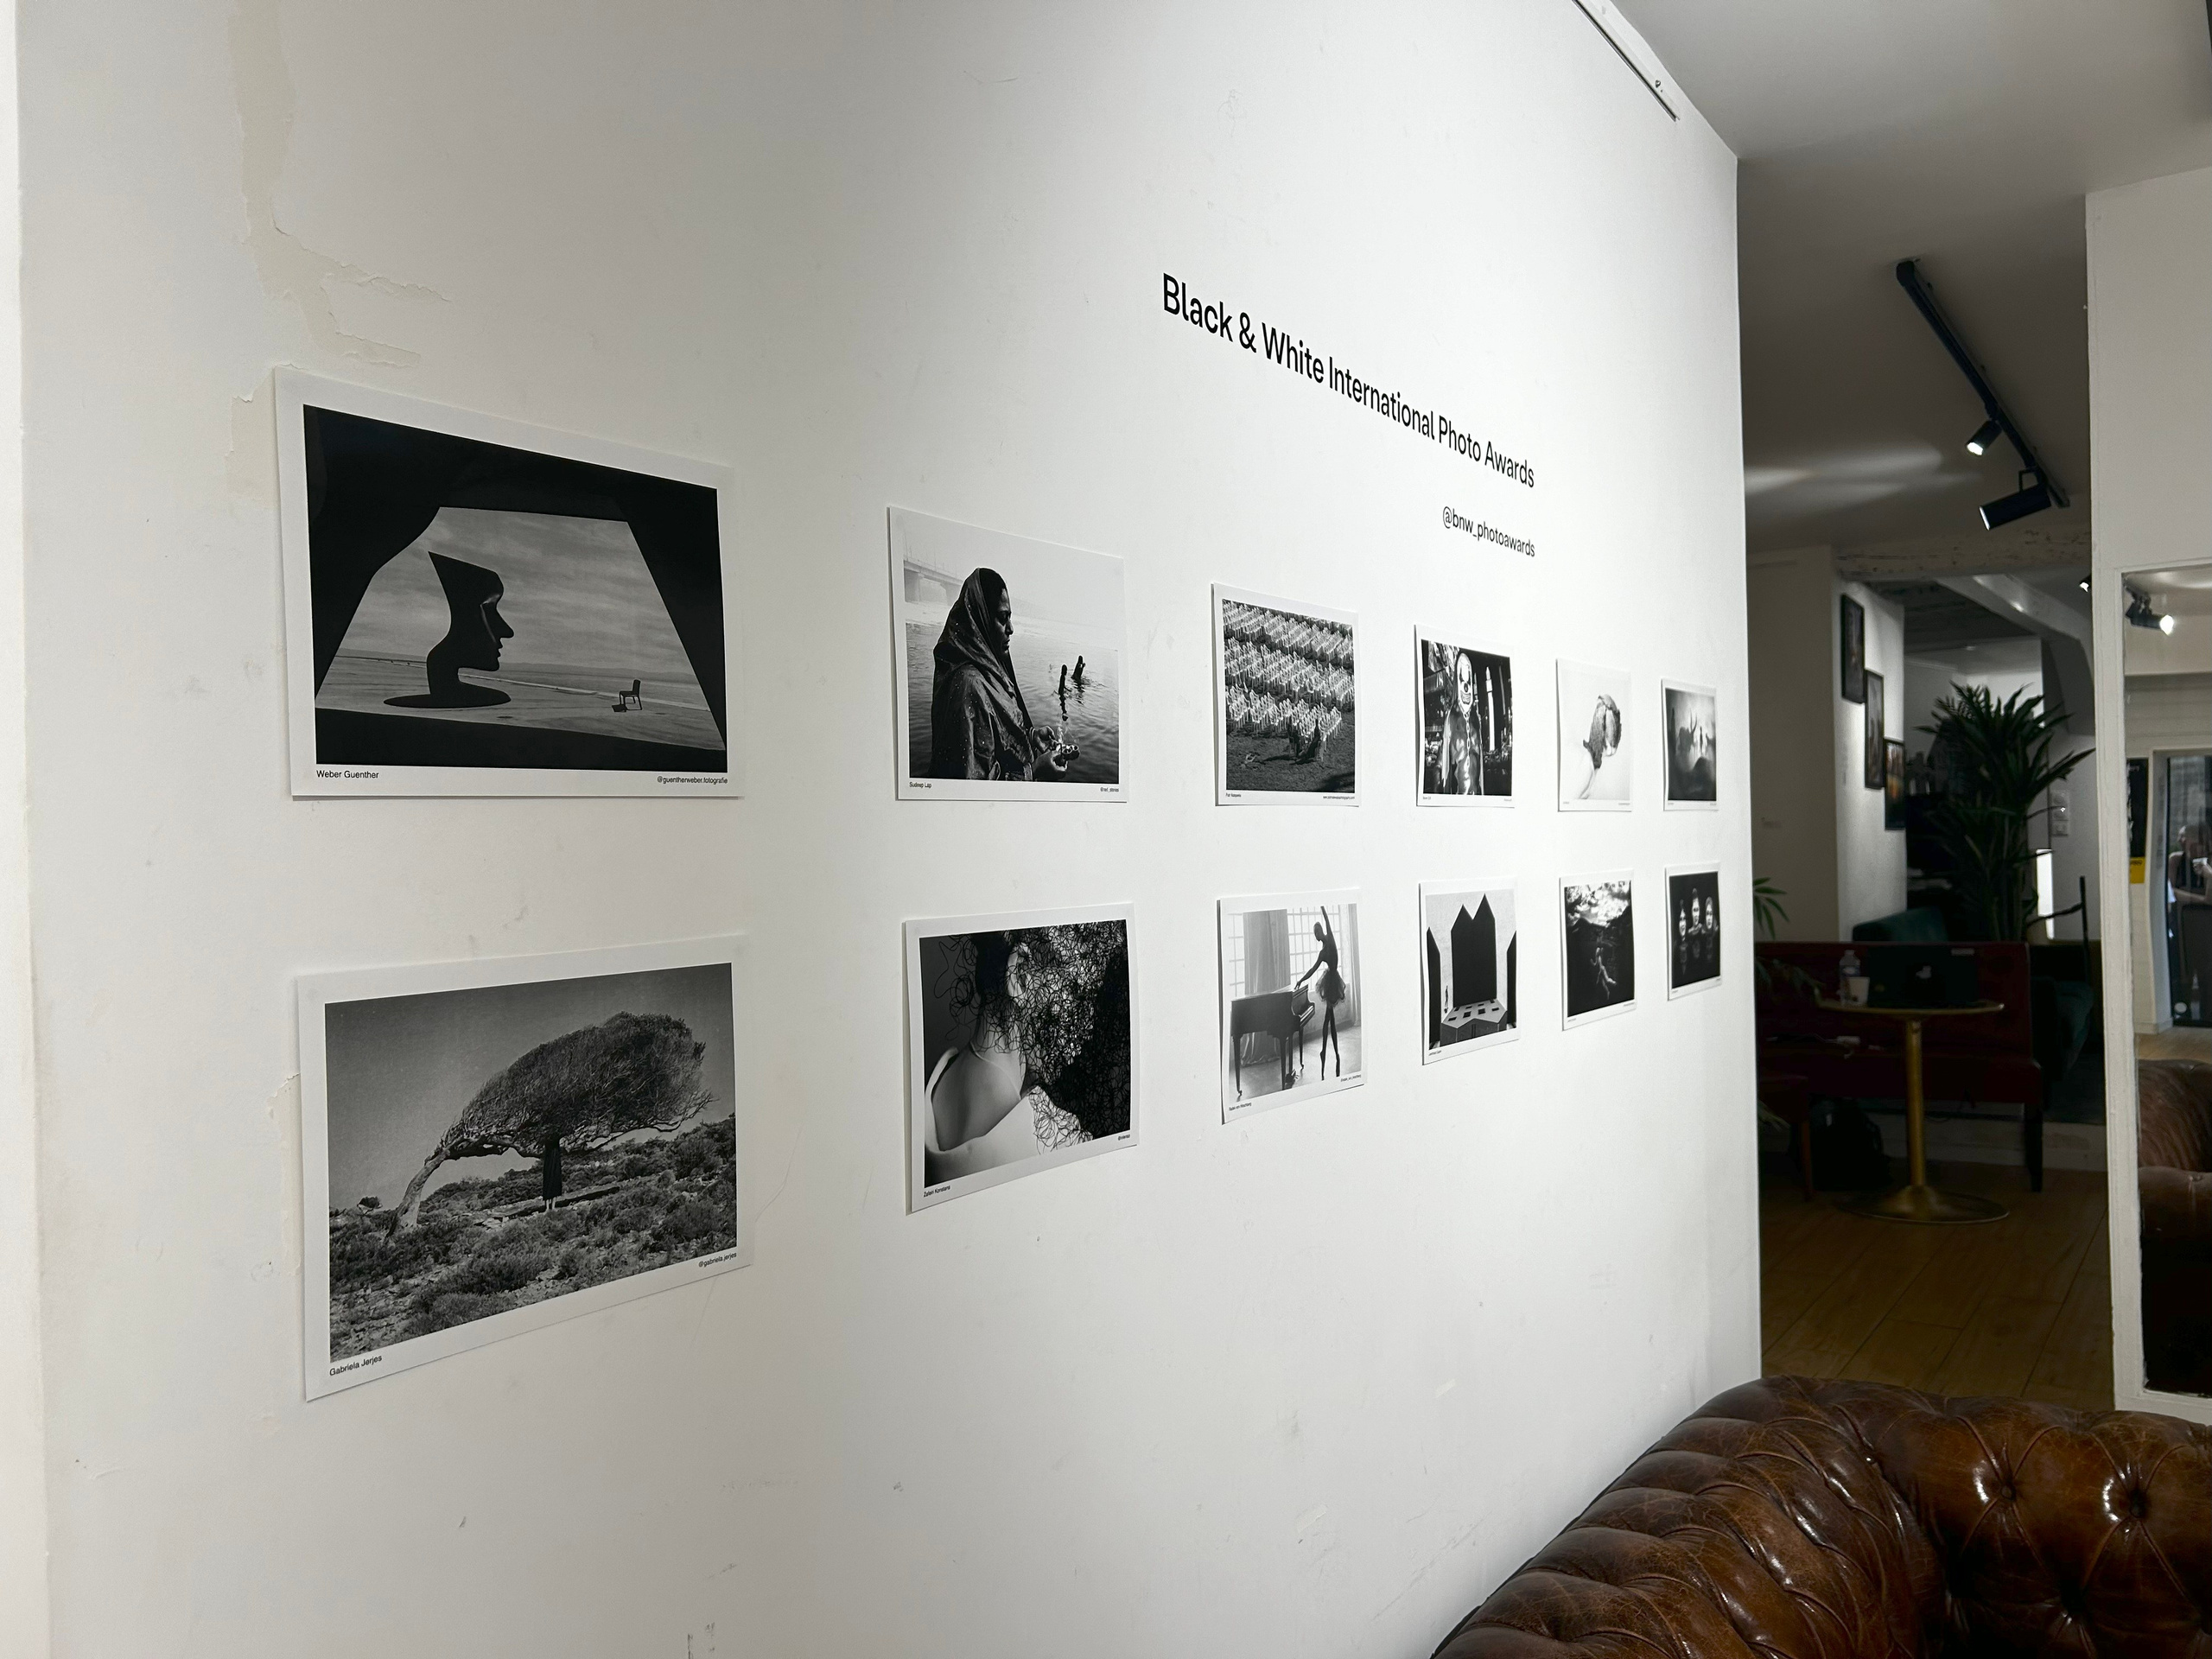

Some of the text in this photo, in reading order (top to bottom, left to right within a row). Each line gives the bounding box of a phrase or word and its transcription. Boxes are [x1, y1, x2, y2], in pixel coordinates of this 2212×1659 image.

[1163, 272, 1535, 488] Black & White International Photo Awards
[1442, 506, 1535, 557] @bnw_photoawards
[344, 770, 379, 779] Guenther
[329, 1355, 382, 1376] Gabriela Jerjes
